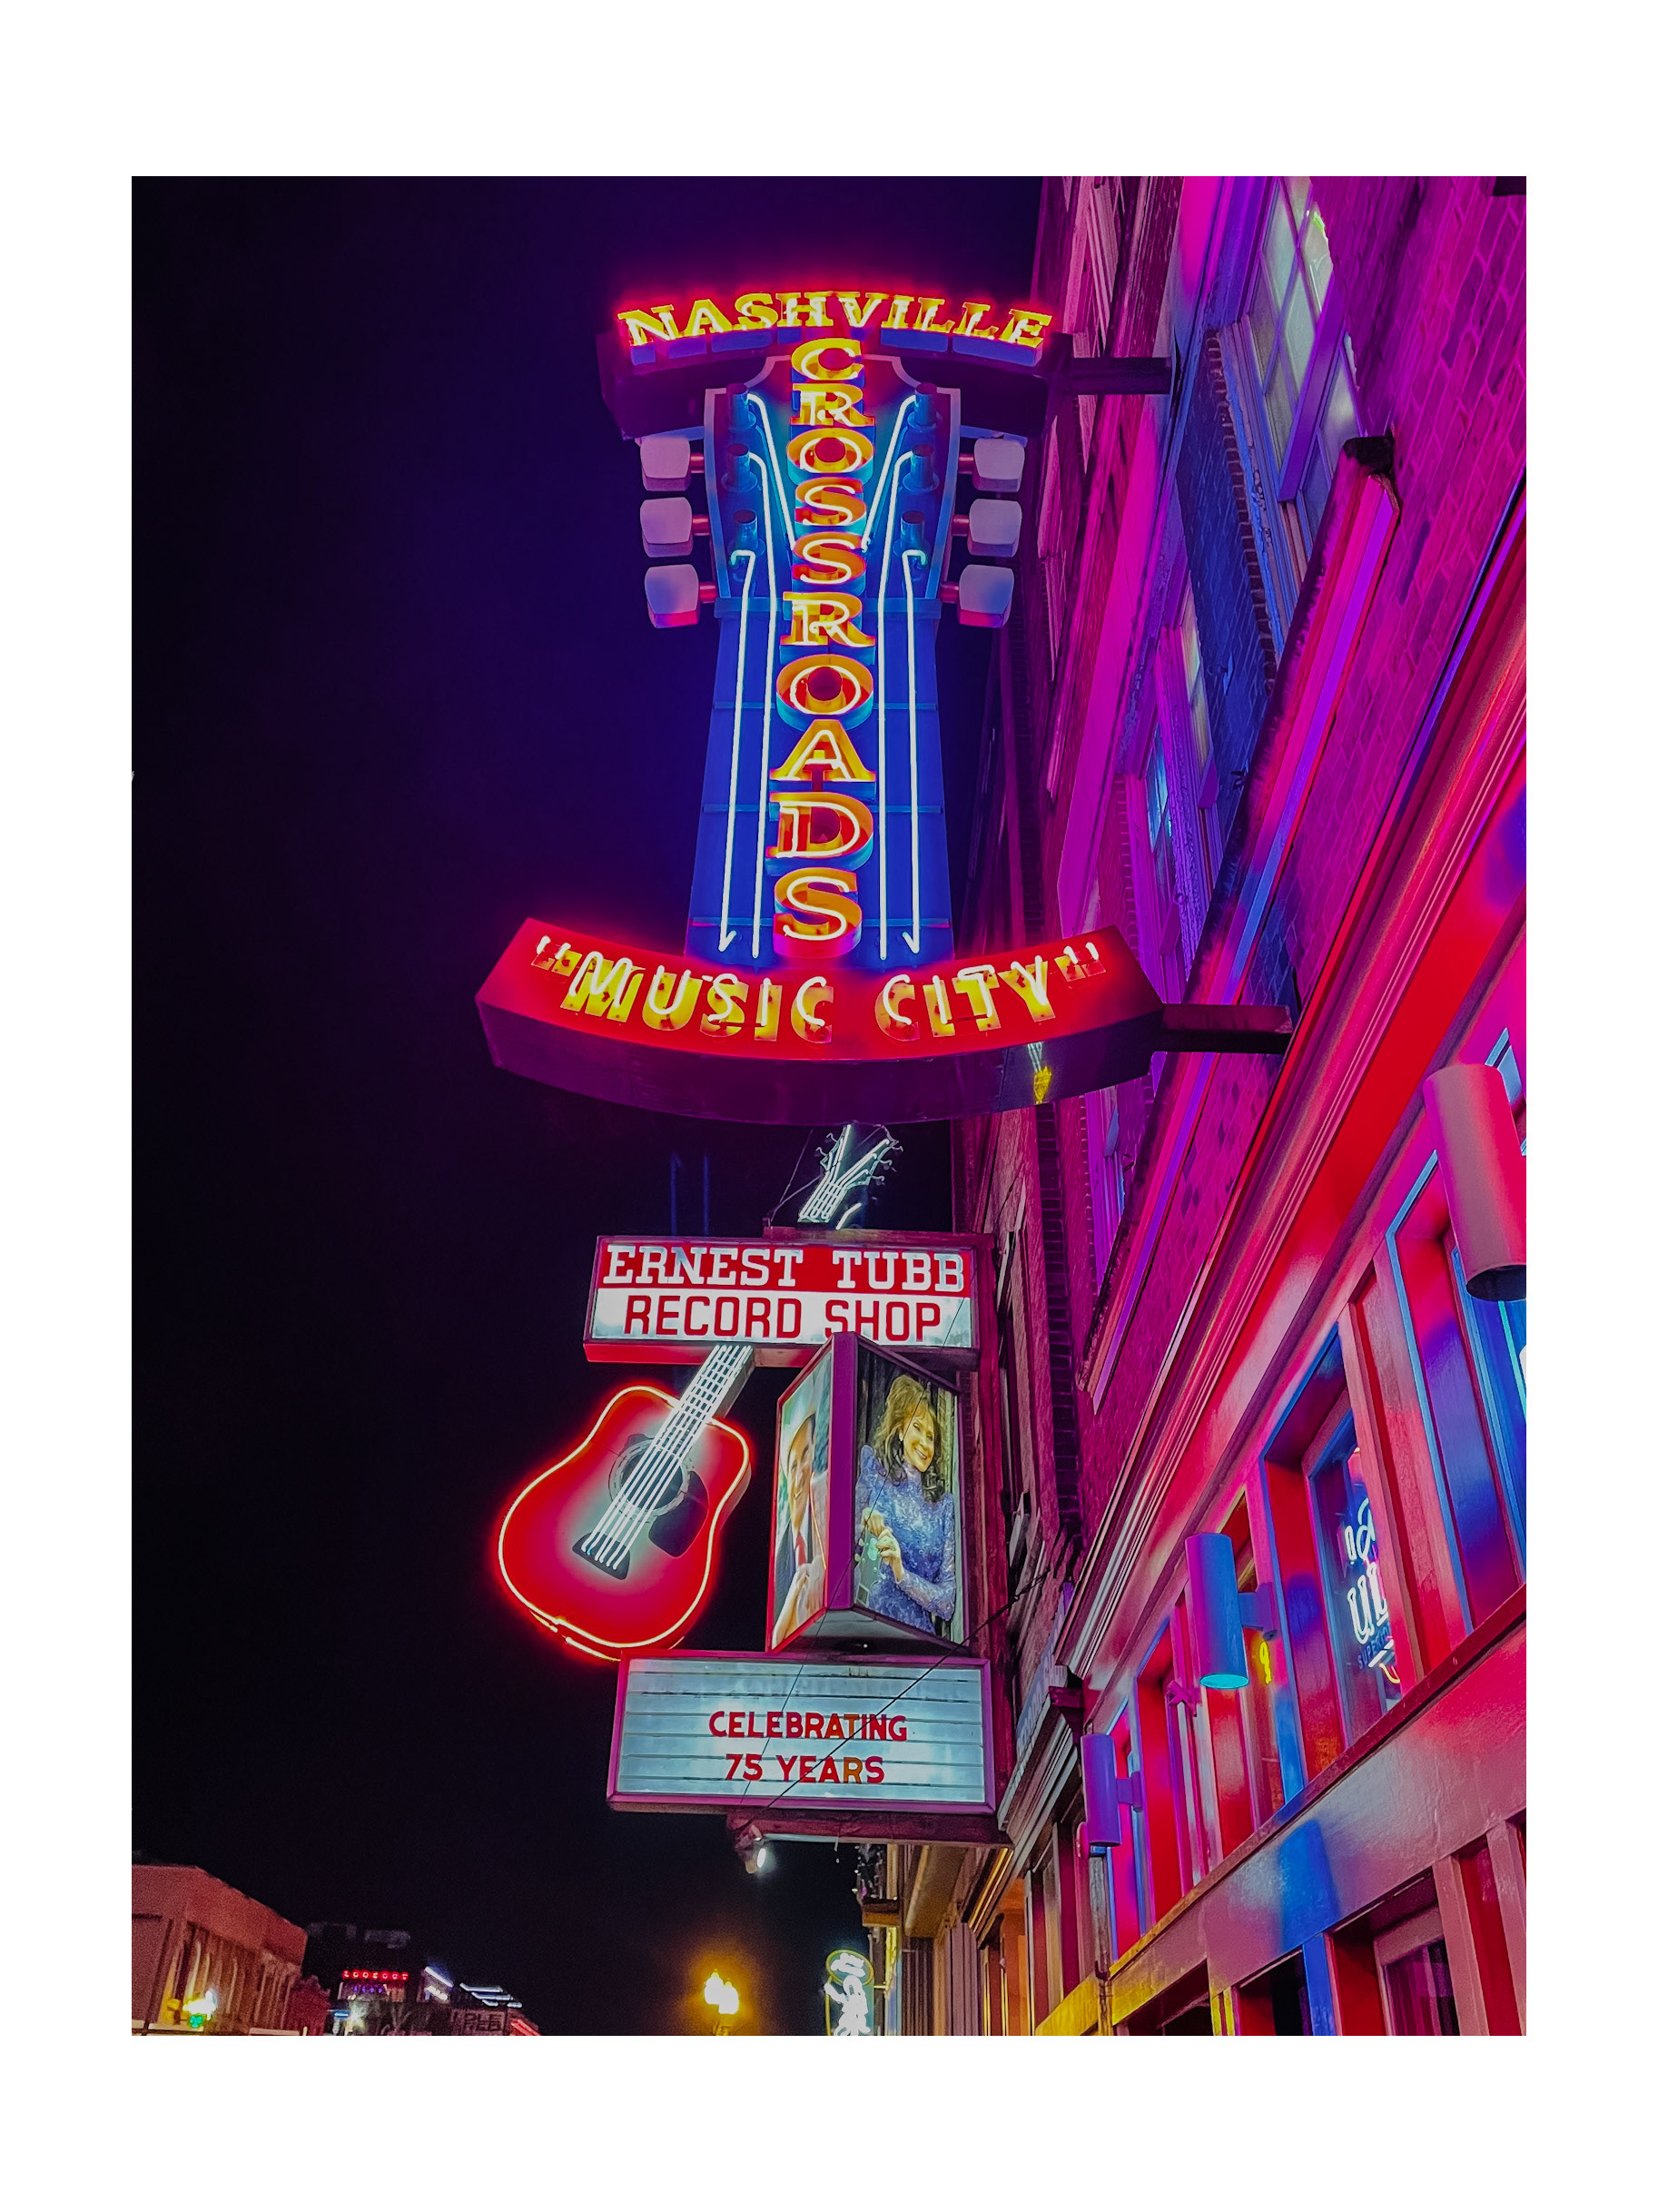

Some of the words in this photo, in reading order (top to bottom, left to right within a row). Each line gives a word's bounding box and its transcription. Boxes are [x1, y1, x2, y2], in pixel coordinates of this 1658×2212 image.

[617, 290, 1053, 349] NASHVILLE
[765, 337, 877, 953] CROSSROADS
[602, 1244, 804, 1288] ERNEST
[832, 1249, 965, 1293] TUBB
[623, 1295, 803, 1339] RECORD
[824, 1299, 942, 1343] SHOP
[708, 1710, 908, 1743] CELEBRATING
[725, 1753, 764, 1782] 75
[775, 1754, 886, 1784] YEARS
